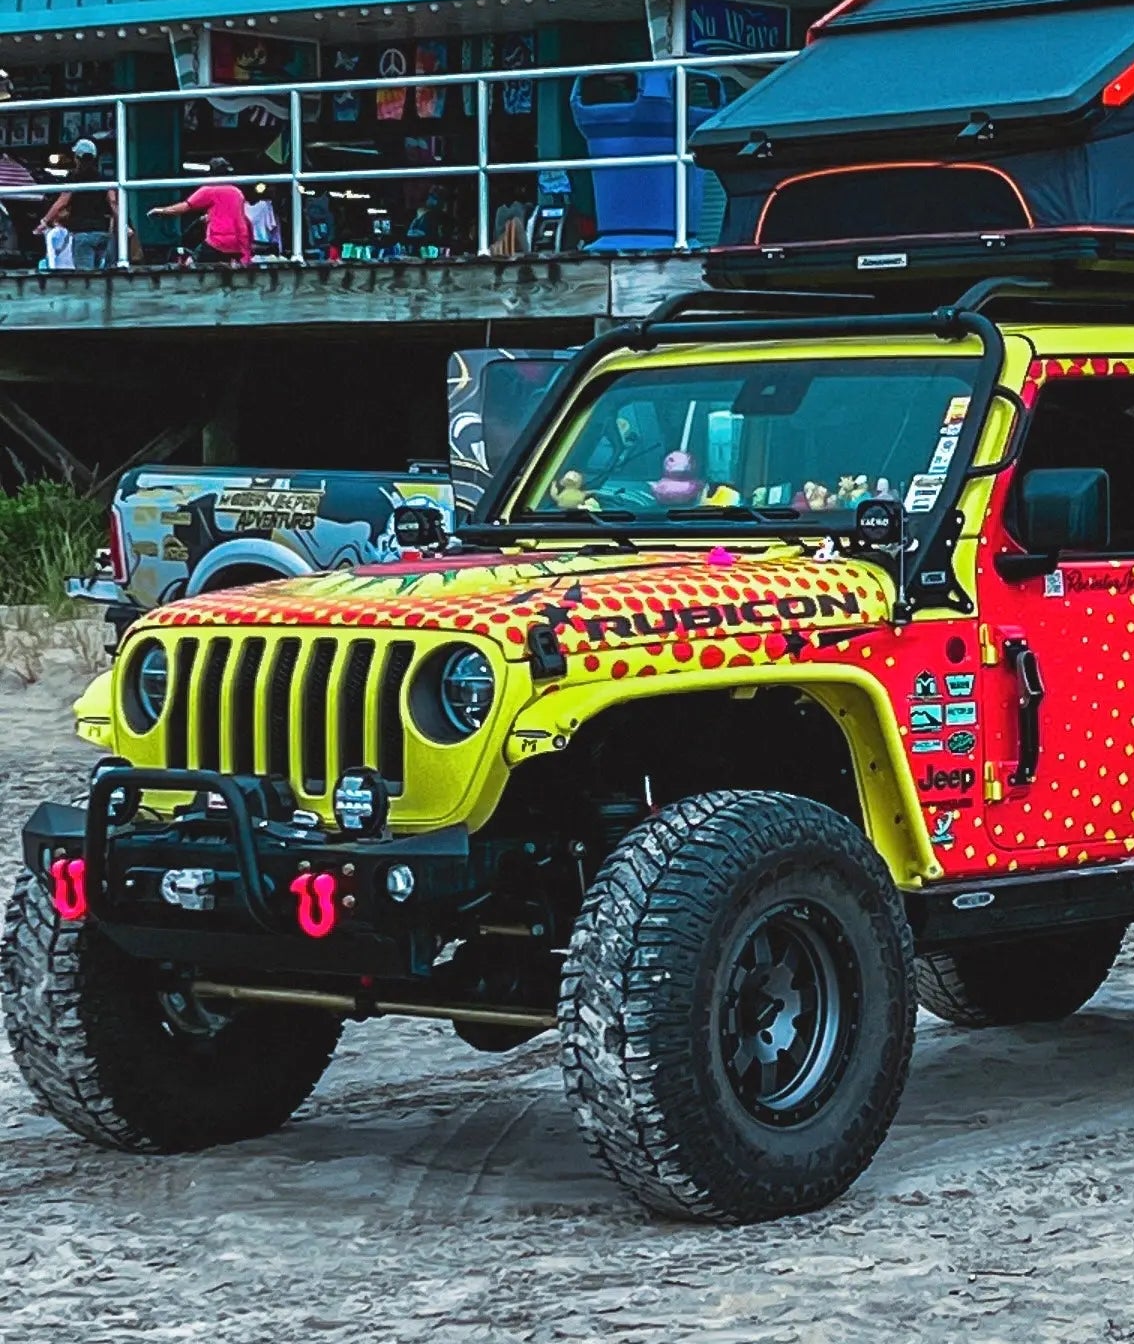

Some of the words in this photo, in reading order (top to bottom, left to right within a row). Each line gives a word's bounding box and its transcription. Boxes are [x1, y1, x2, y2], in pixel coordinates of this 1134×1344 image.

[691, 7, 716, 41] Nu
[724, 7, 779, 49] Wave
[586, 592, 860, 642] RUBICON
[918, 764, 975, 794] Jeep
